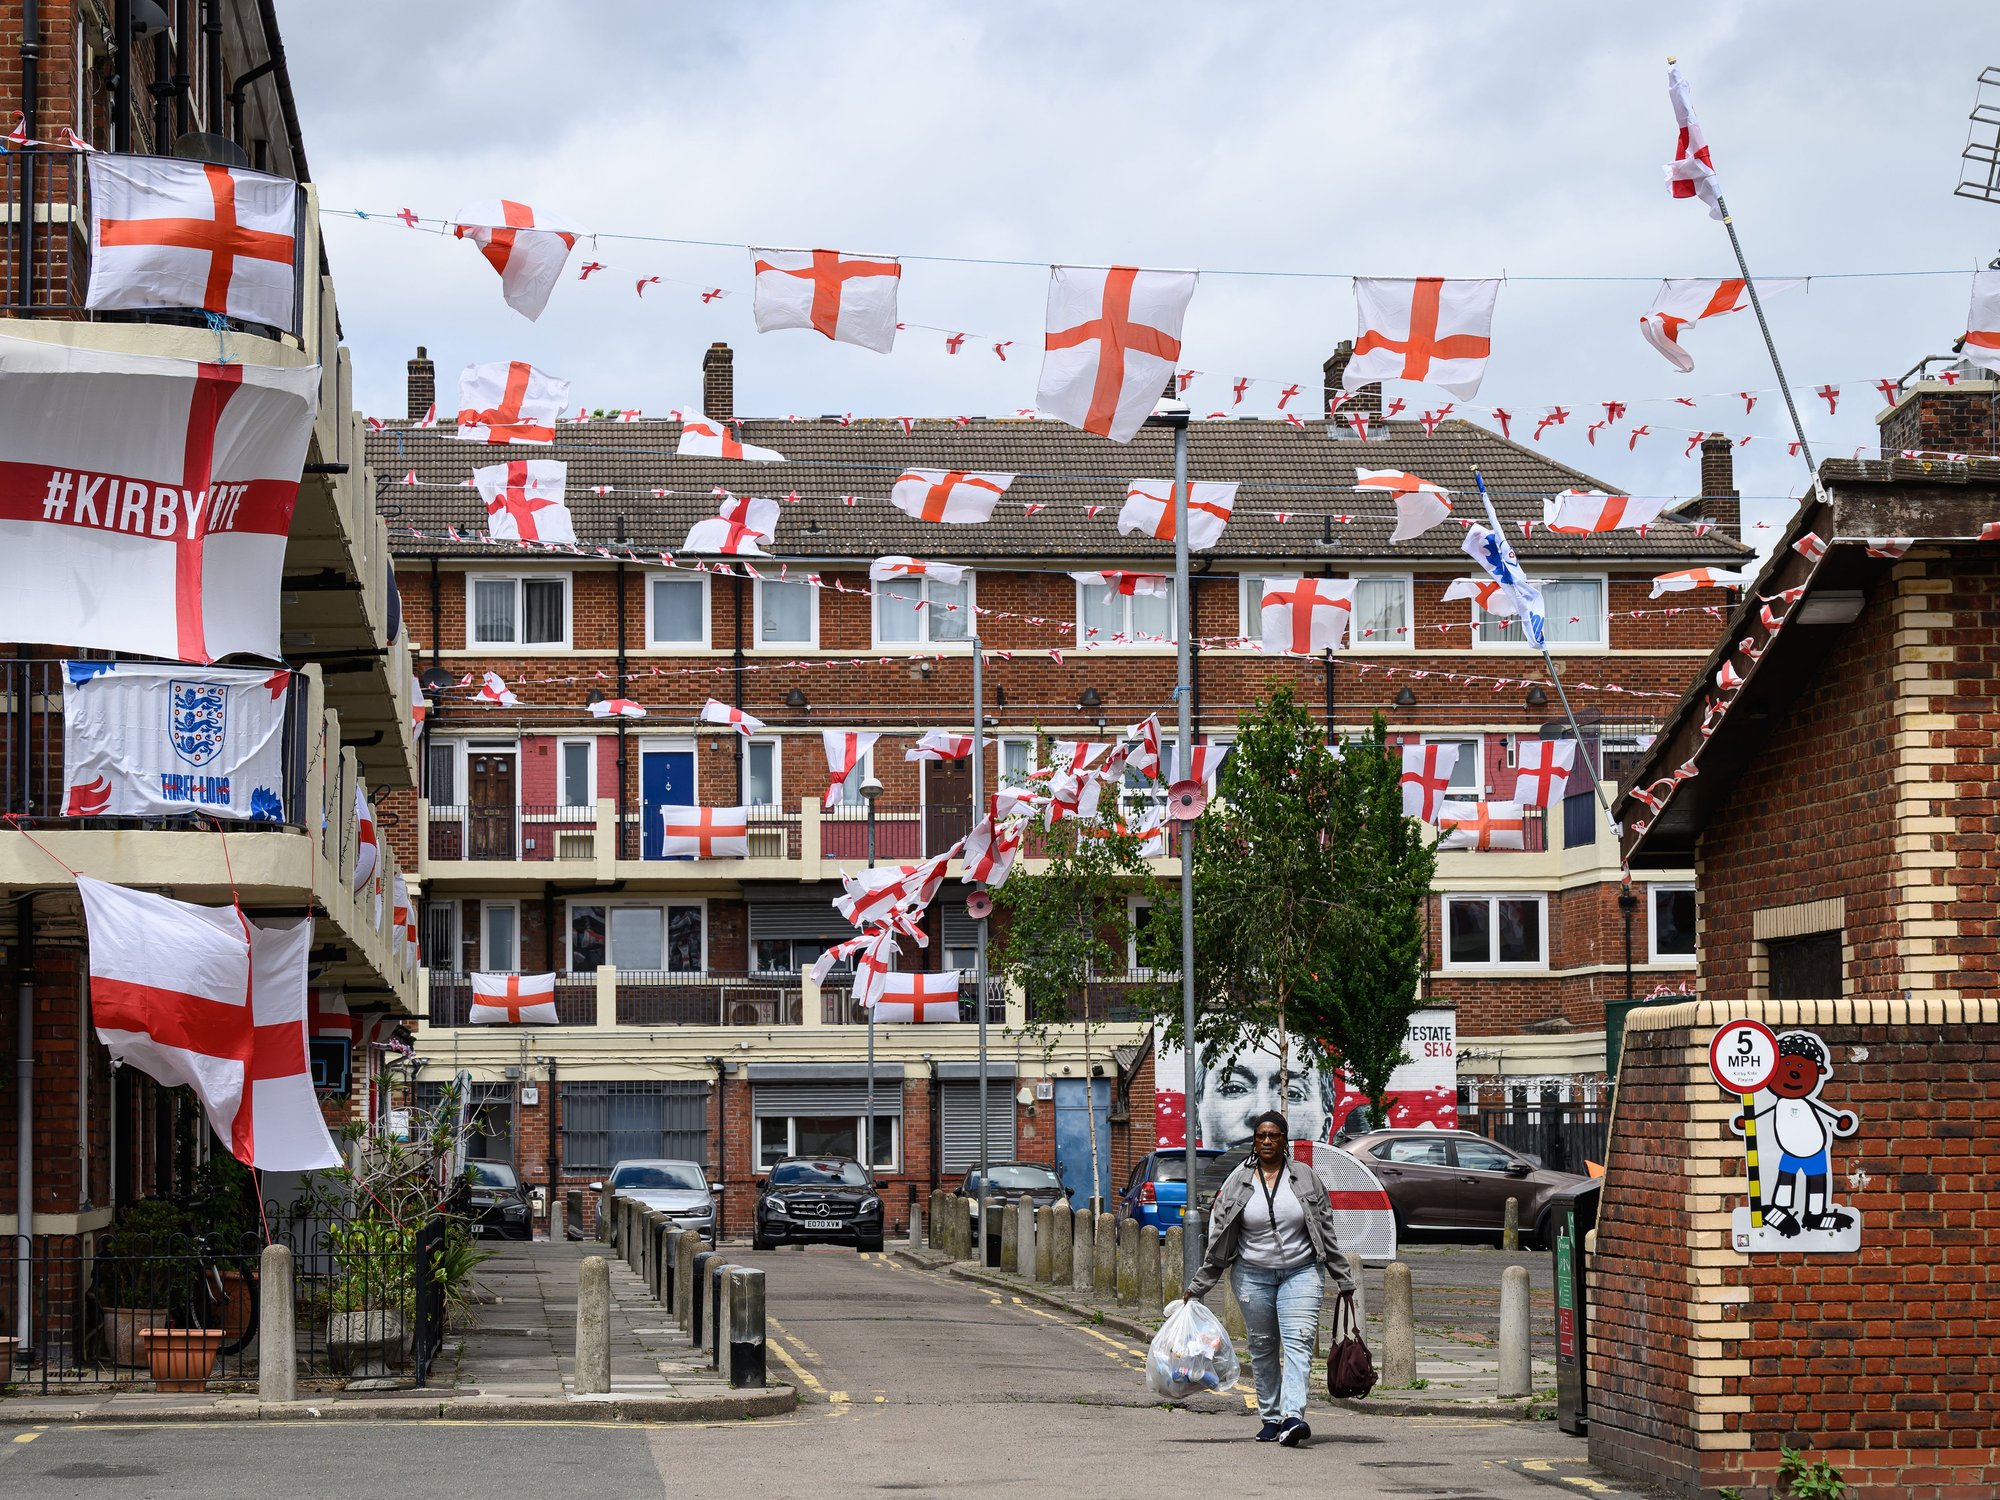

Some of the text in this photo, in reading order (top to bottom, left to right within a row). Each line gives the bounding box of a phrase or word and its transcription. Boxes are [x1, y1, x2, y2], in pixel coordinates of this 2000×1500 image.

[199, 775, 231, 805] LIONS
[1424, 1041, 1453, 1057] SE16
[1737, 1031, 1753, 1055] 5
[1728, 1055, 1761, 1067] MPH
